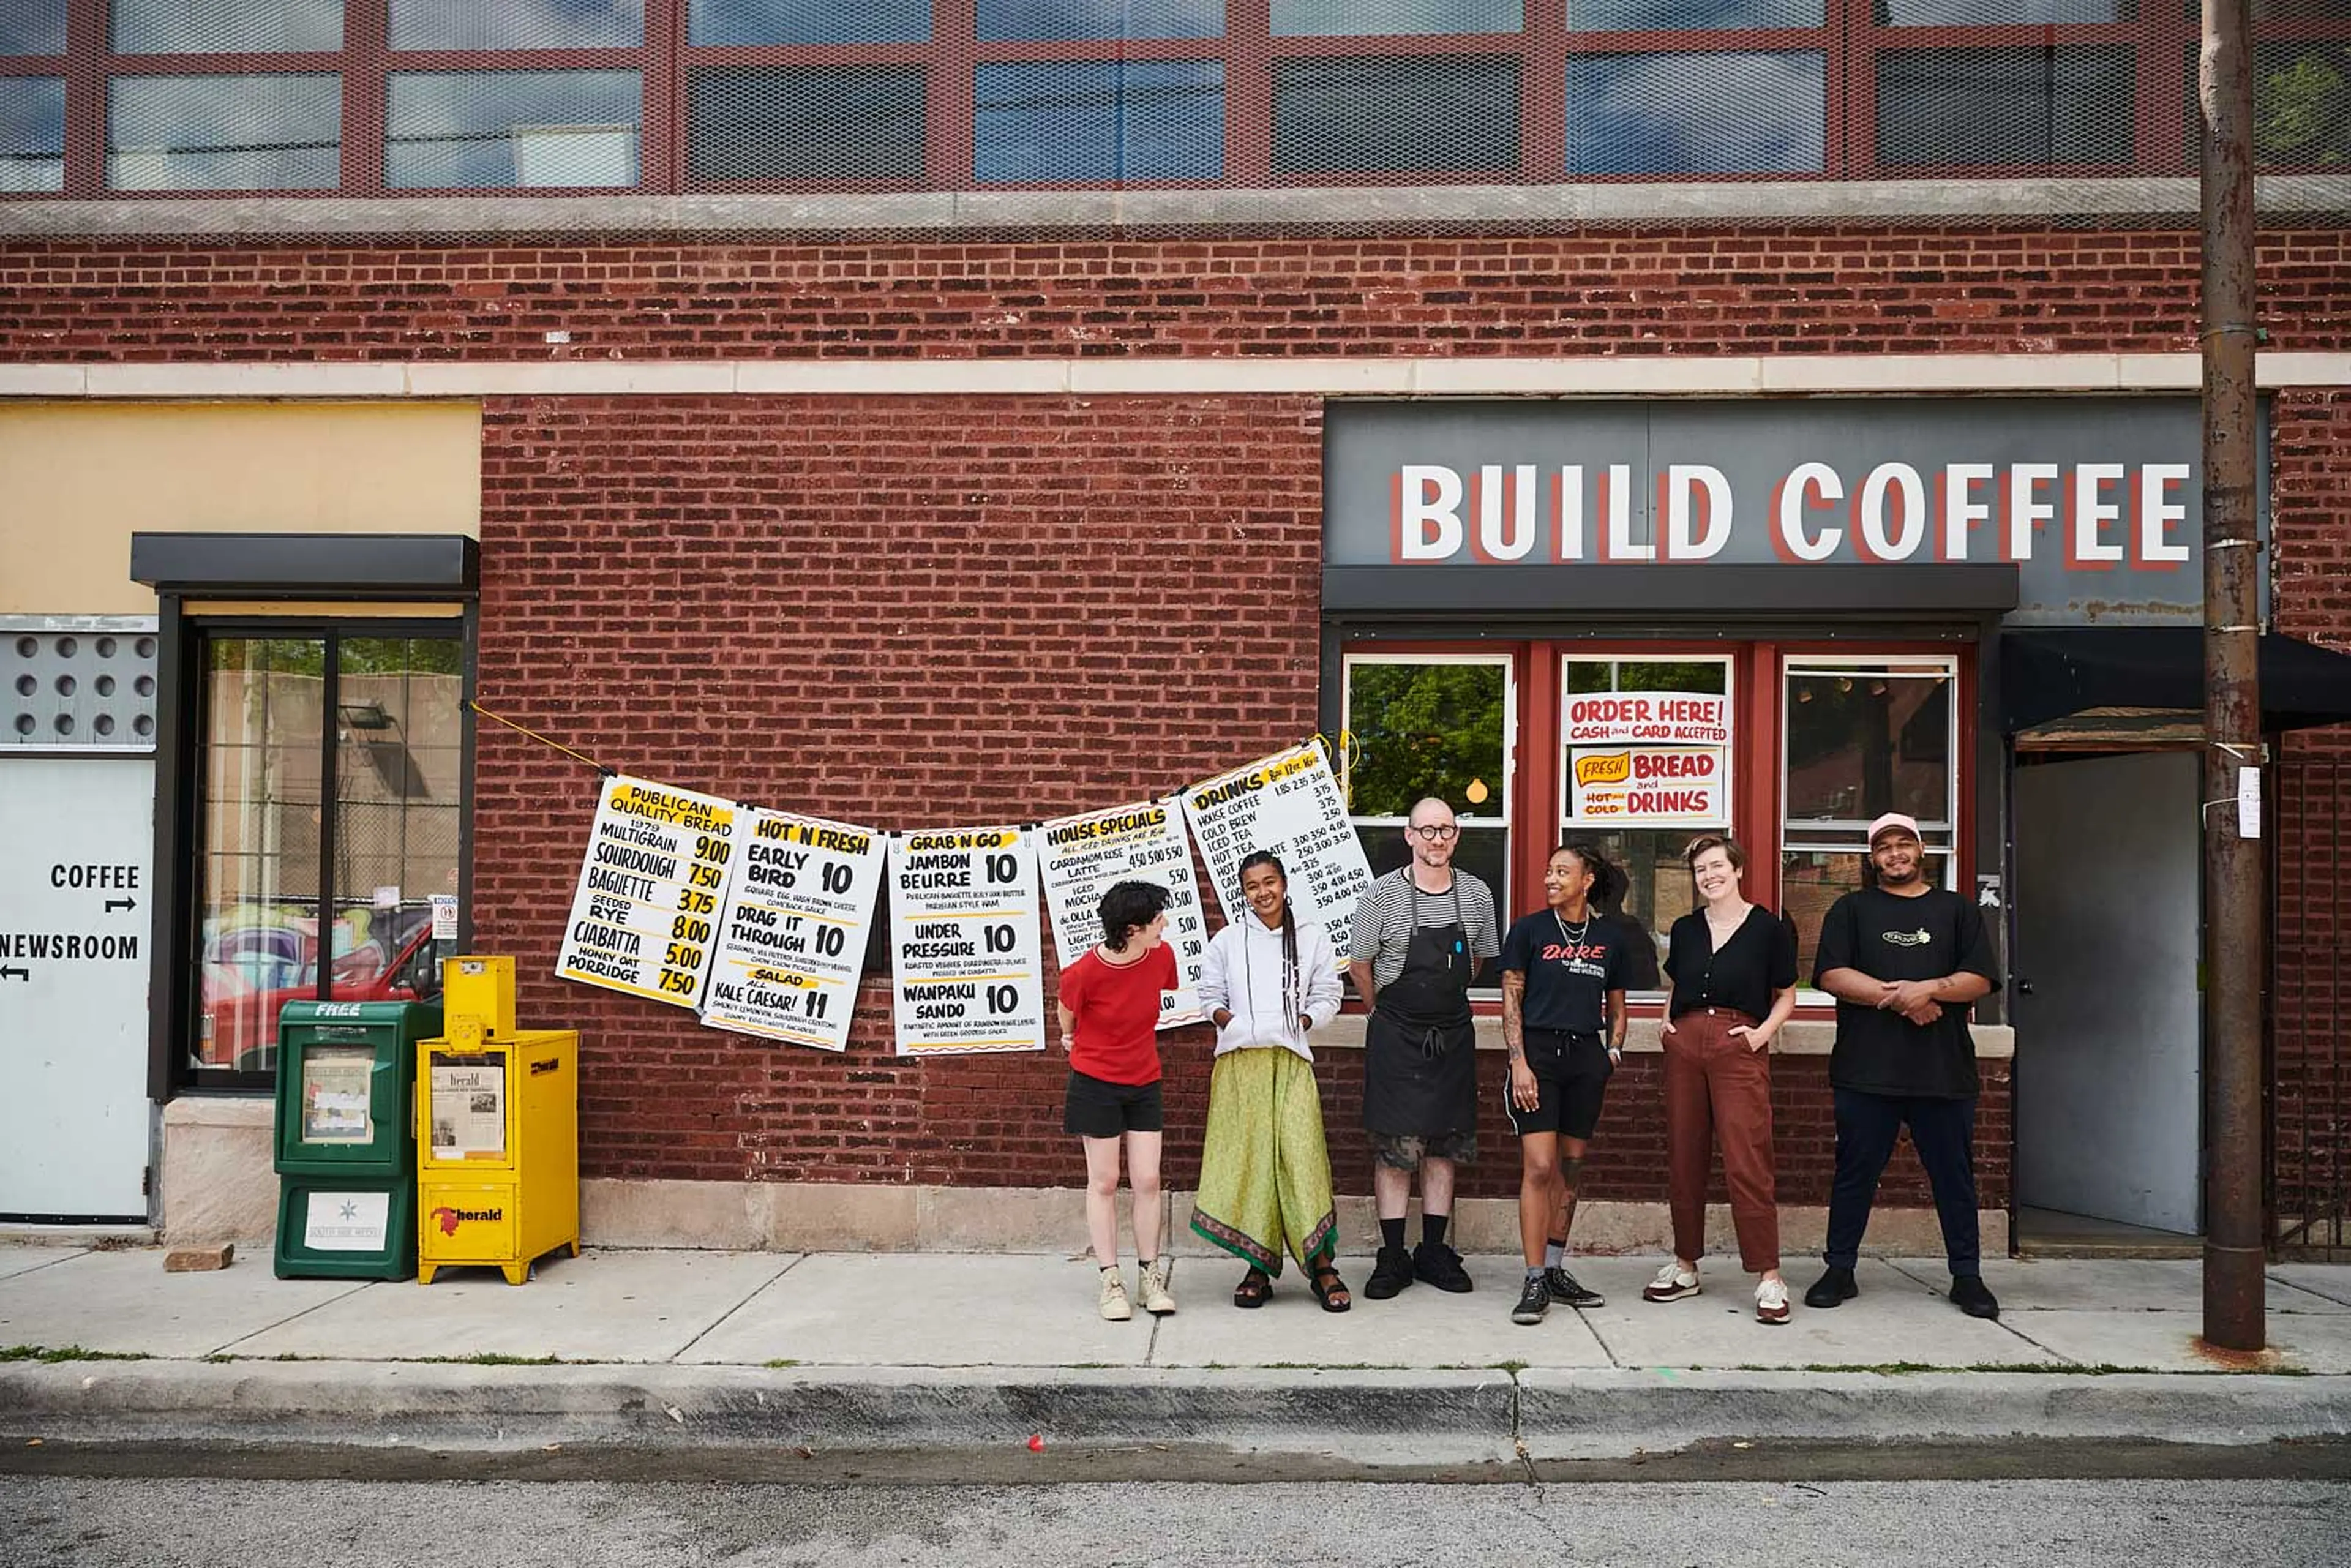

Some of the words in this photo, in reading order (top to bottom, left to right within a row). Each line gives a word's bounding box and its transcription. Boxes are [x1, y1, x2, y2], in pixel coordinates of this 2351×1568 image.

[1391, 464, 1733, 565] BUILD
[1769, 462, 2190, 571] COFFEE
[1571, 700, 1652, 723] ORDER
[1659, 700, 1723, 726] HERE!
[1571, 726, 1609, 739] CASH
[1611, 726, 1629, 735] and
[1632, 725, 1671, 738] CARD
[1675, 727, 1727, 740] ACCEPTED
[1584, 760, 1624, 778] FRESH
[1634, 754, 1714, 778] BREAD
[1194, 773, 1264, 810] DRINKS
[1637, 780, 1658, 790] and
[631, 787, 712, 817] PUBLICAN
[1586, 793, 1610, 802] HOT
[1627, 790, 1708, 813] DRINKS
[612, 799, 679, 823] QUALITY
[684, 814, 732, 836] BREAD
[1197, 806, 1224, 827] HOUSE
[1228, 795, 1262, 816] COFFEE
[1586, 805, 1619, 814] COLD
[631, 820, 660, 832] 1979
[758, 820, 794, 841] HOT
[818, 829, 869, 855] FRESH
[1048, 822, 1097, 846] HOUSE
[1100, 809, 1166, 835] SPECIALS
[1201, 823, 1226, 841] COLD
[1229, 811, 1257, 830] BREW
[601, 823, 677, 852] MULTIGRAIN
[695, 836, 730, 864] 9.00
[910, 835, 956, 850] GRAB
[976, 833, 1001, 847] GO
[1062, 845, 1076, 854] ALL
[1081, 841, 1099, 851] ICED
[1102, 835, 1131, 846] DRINKS
[1208, 837, 1230, 852] ICED
[1233, 828, 1252, 843] TEA
[748, 845, 809, 869] EARLY
[906, 853, 970, 870] JAMBON
[1050, 853, 1103, 870] CARDAMOM
[1212, 849, 1231, 865] HOT
[1232, 841, 1256, 855] TEA
[51, 865, 138, 888] COFFEE
[594, 842, 676, 879] SOURDOUGH
[689, 863, 722, 889] 7.50
[748, 865, 795, 888] BIRD
[986, 854, 1017, 883] 10
[1068, 865, 1100, 877] LATTE
[1217, 861, 1235, 877] HOT
[822, 862, 853, 894] 10
[901, 872, 971, 889] BEURRE
[1073, 884, 1094, 895] ICED
[588, 867, 656, 902] BAGUETTE
[678, 889, 714, 914] 3.75
[592, 895, 632, 909] SEEDED
[1065, 893, 1102, 909] MOCHA
[590, 905, 629, 925] RYE
[672, 915, 710, 943] 8.00
[737, 906, 776, 926] DRAG
[786, 915, 803, 931] IT
[1070, 909, 1093, 922] OLLA
[731, 924, 806, 953] THROUGH
[816, 925, 844, 956] 10
[915, 923, 962, 939] UNDER
[984, 924, 1016, 952] 10
[1068, 934, 1092, 945] LIGHT
[0, 934, 137, 959] NEWSROOM
[574, 921, 640, 955] CIABATTA
[665, 943, 702, 969] 5.00
[902, 942, 975, 958] PRESSURE
[579, 947, 615, 962] HONEY
[620, 956, 640, 967] OAT
[567, 955, 640, 984] PORRIDGE
[659, 968, 694, 994] 7.50
[754, 969, 803, 986] SALAD
[715, 982, 743, 1002] KALE
[747, 989, 798, 1011] CAESAR!
[903, 983, 975, 1002] WANPAKU
[986, 985, 1018, 1014] 10
[315, 1003, 361, 1016] FREE
[806, 991, 828, 1019] 11
[917, 1003, 965, 1019] SANDO
[457, 1209, 501, 1220] herald
